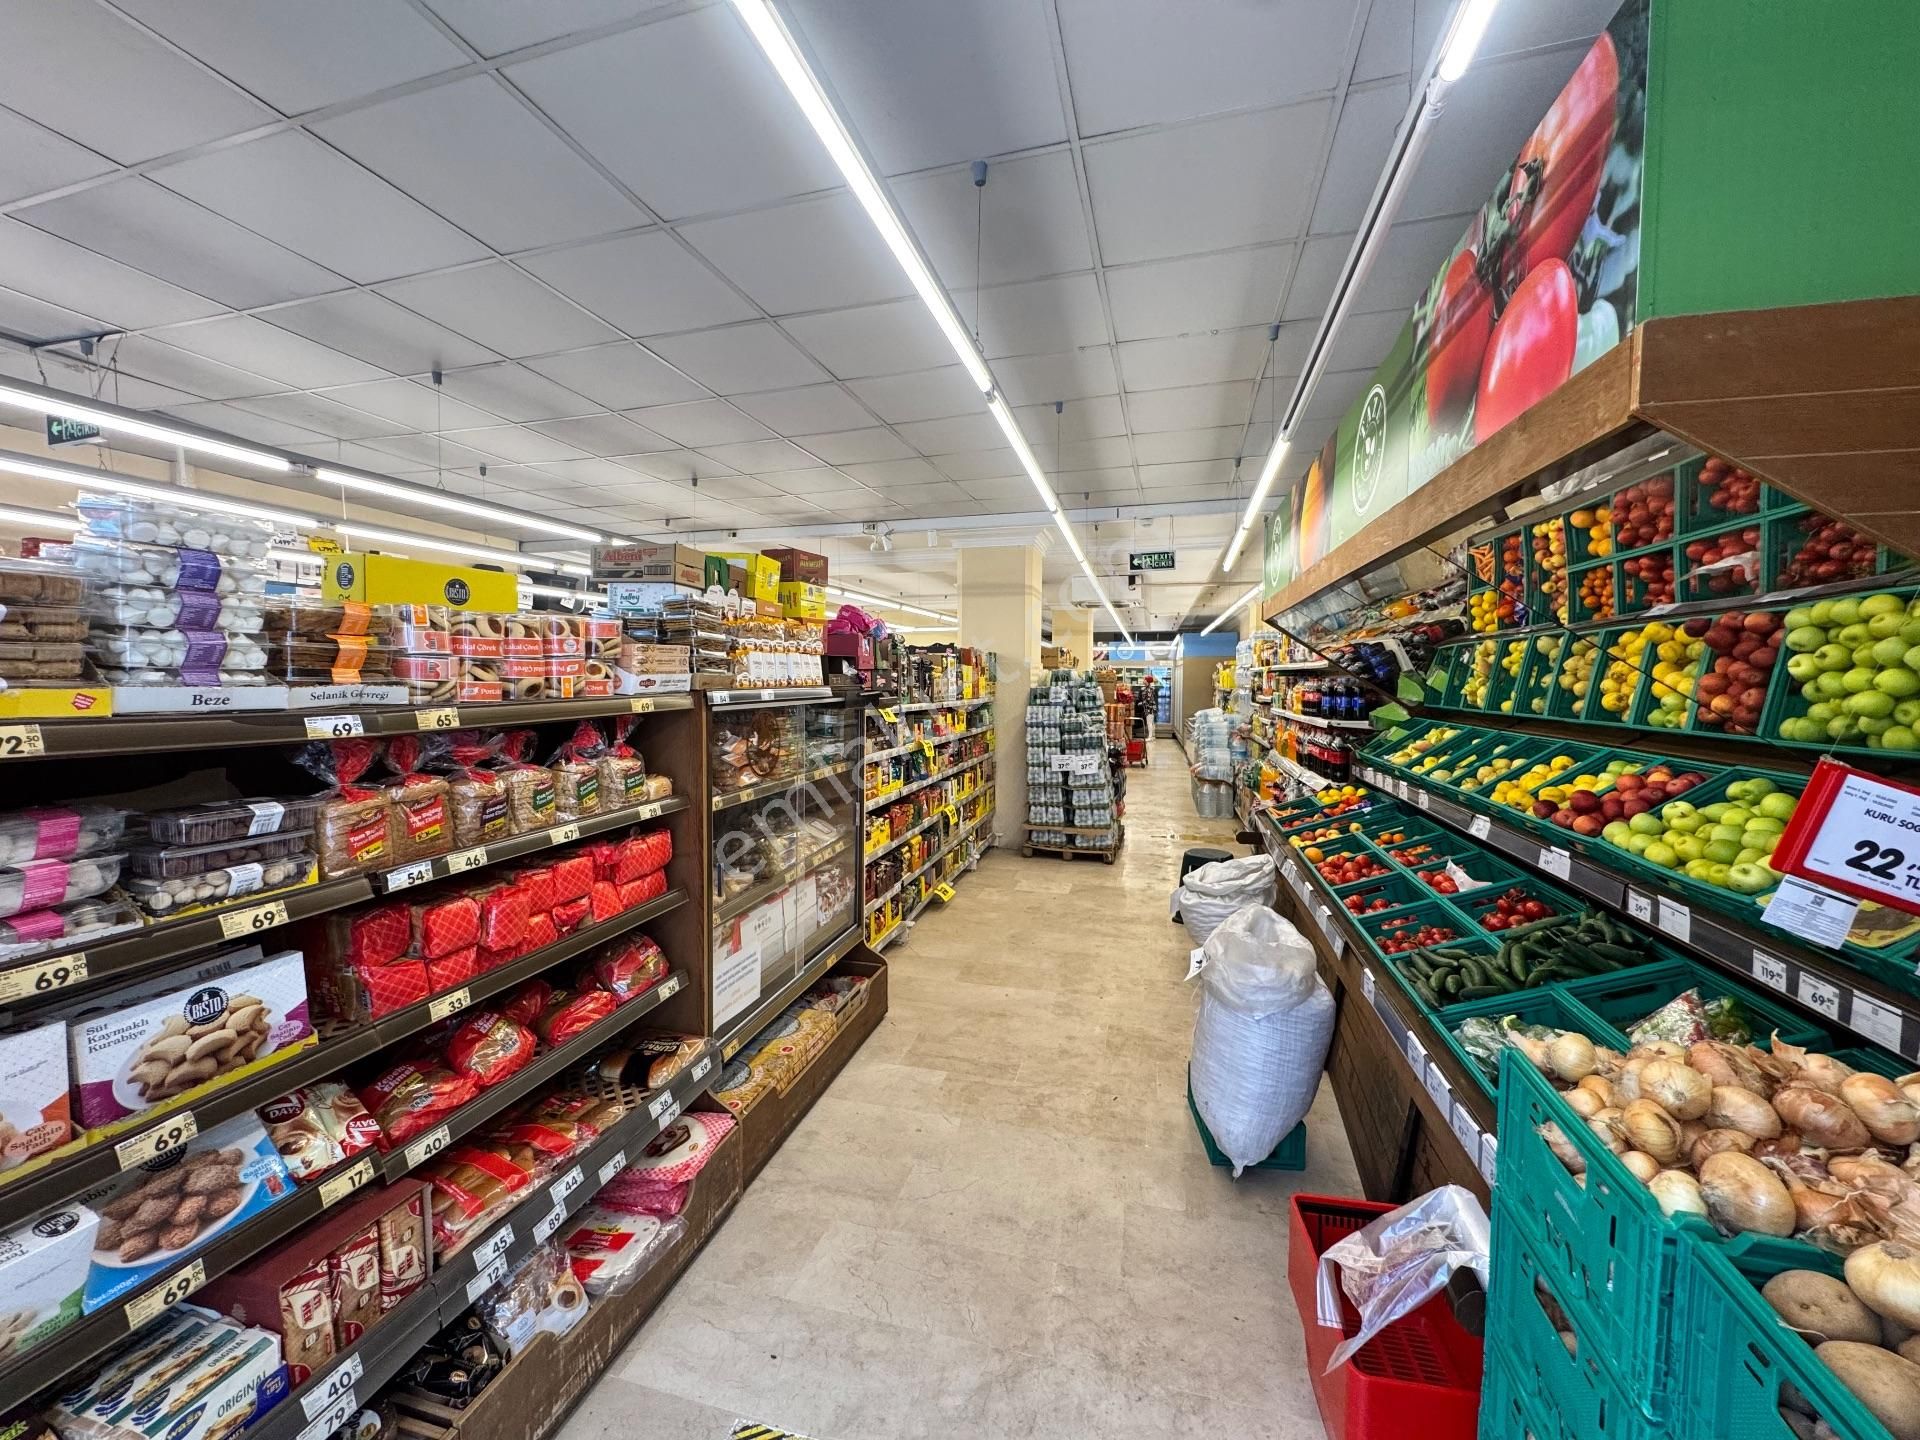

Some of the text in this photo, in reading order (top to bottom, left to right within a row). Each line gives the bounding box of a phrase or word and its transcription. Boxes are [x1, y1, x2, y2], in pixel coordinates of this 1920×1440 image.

[191, 694, 231, 706] Beze
[310, 689, 348, 701] Selanik
[641, 702, 650, 712] 69
[332, 722, 353, 737] 69
[436, 714, 451, 727] 65
[0, 736, 25, 754] 2
[1864, 808, 1897, 824] KURU
[563, 830, 574, 841] 47
[464, 854, 481, 868] 46
[1845, 839, 1905, 880] 22
[407, 870, 425, 885] 54
[252, 911, 275, 929] 69
[35, 967, 70, 991] 69
[448, 998, 464, 1013] 33
[1810, 992, 1825, 1006] 69
[86, 1024, 109, 1035] Süt
[87, 1018, 149, 1045] Kaymaklı
[88, 1029, 147, 1054] Kurabiye
[269, 1106, 301, 1119] DAYS
[660, 1100, 669, 1111] 36
[154, 1126, 182, 1152] 69
[423, 1137, 442, 1156] 40
[348, 1169, 363, 1189] 17
[565, 1175, 578, 1192] 44
[548, 1212, 561, 1231] 89
[492, 1235, 508, 1254] 45
[487, 1266, 501, 1284] 12
[163, 1276, 191, 1306] 69
[207, 1338, 249, 1368] ORIGINAL
[328, 1371, 352, 1399] 40
[324, 1406, 346, 1435] 79
